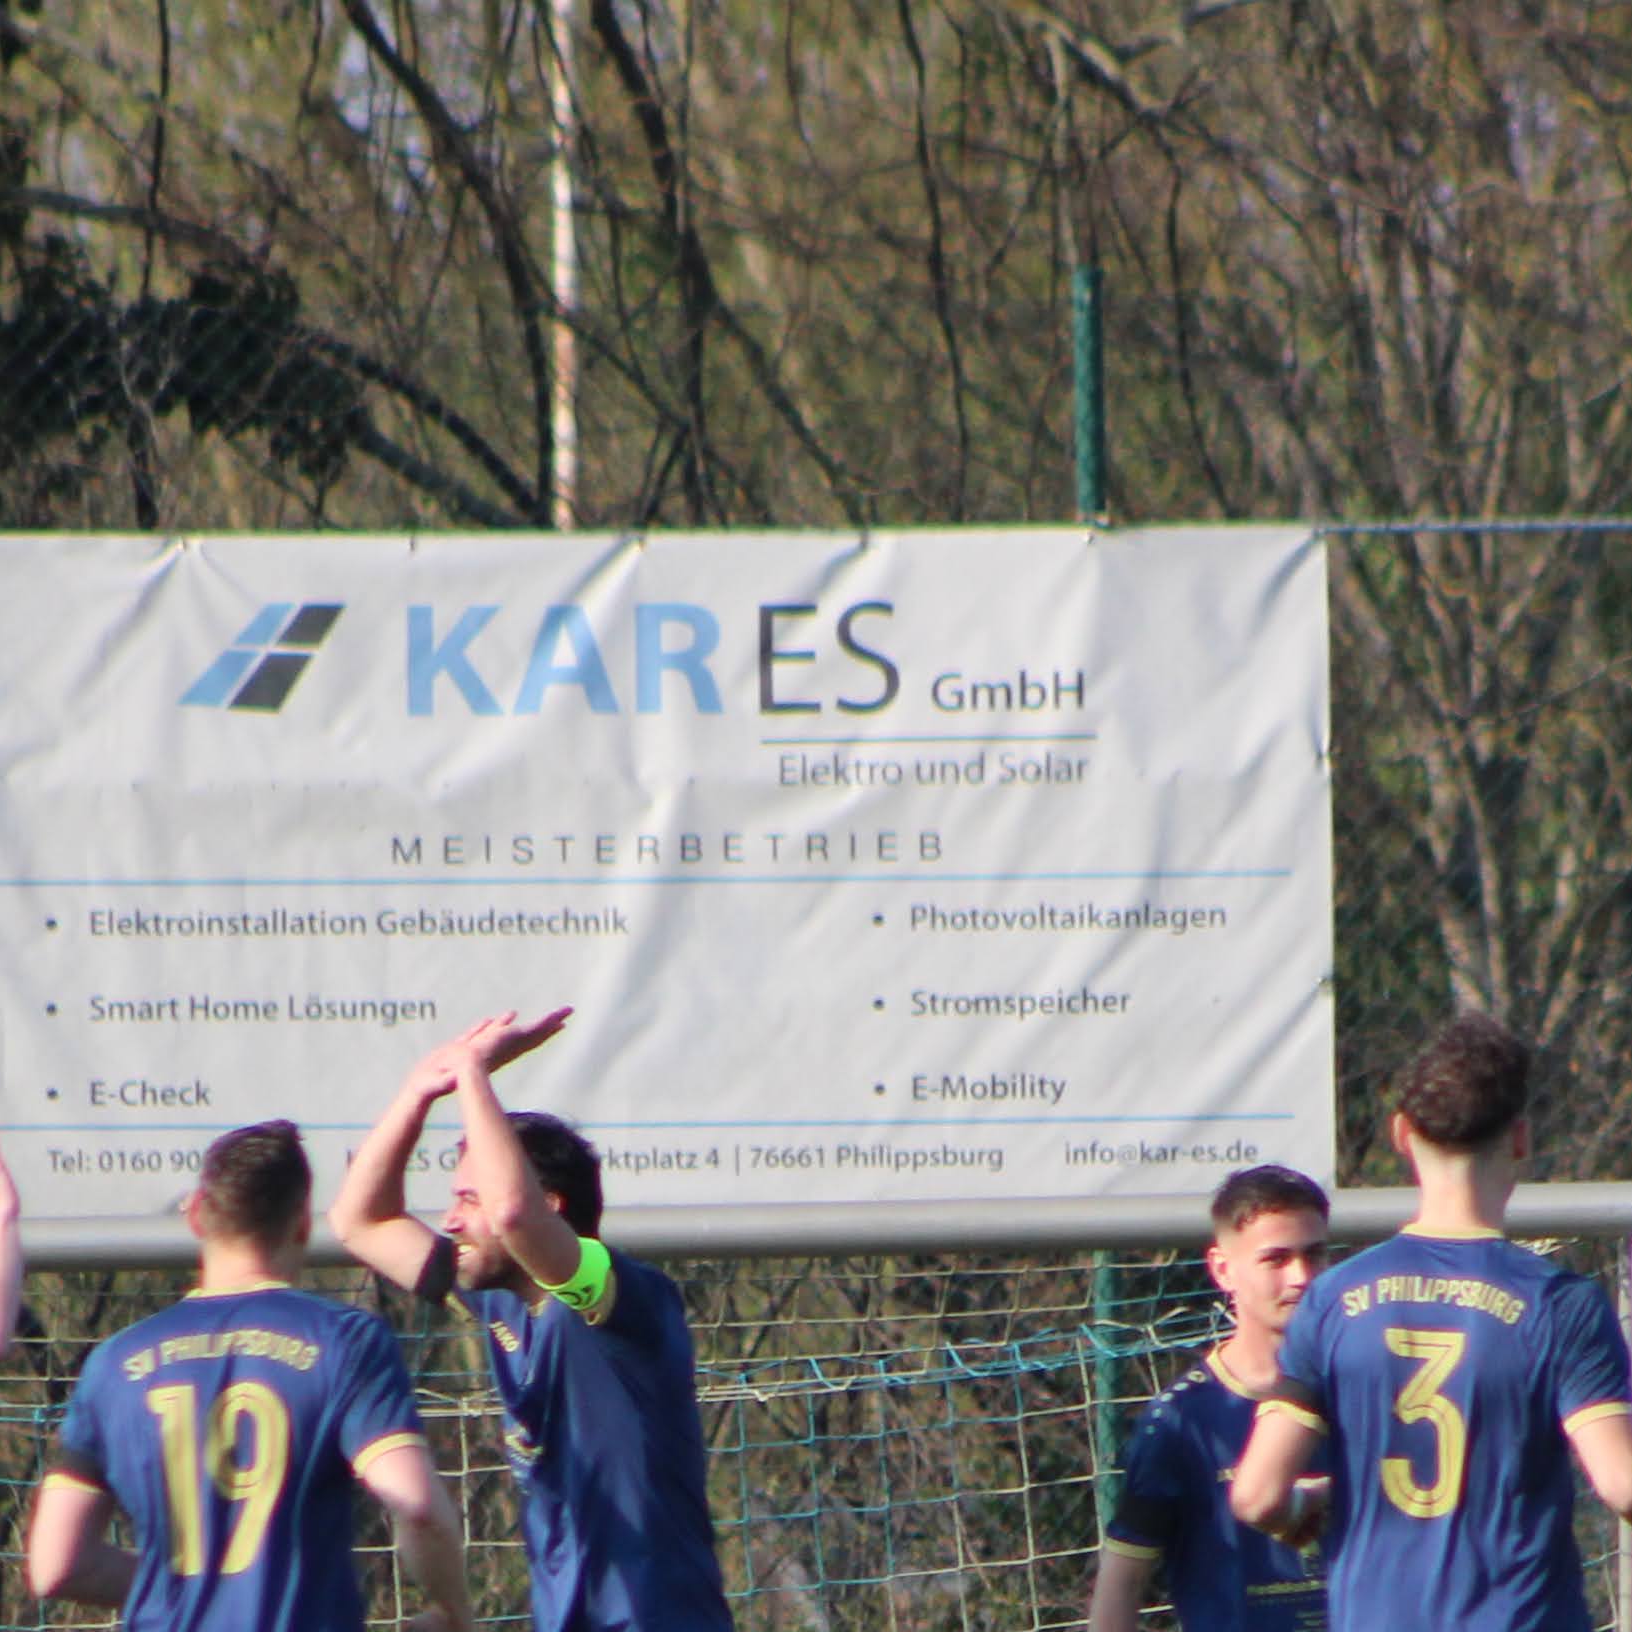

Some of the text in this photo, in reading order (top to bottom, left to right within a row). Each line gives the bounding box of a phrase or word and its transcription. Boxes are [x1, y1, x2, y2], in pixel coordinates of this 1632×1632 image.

[406, 601, 1088, 716] KARES GmbH
[778, 751, 1090, 787] Elektro und Solar
[391, 831, 944, 866] MEISTERBETRIEB
[89, 907, 629, 937] Elektroinstallation Gebäudetechnik
[910, 903, 1228, 936] Photovoltaikanlagen
[89, 995, 439, 1029] Smart Home Lösungen
[910, 988, 1133, 1020] Stromspeicher
[89, 1079, 213, 1107] E-Check
[910, 1073, 1069, 1106] E-Mobility
[47, 1149, 205, 1174] Tel: 0160 90
[705, 1147, 724, 1170] 4
[750, 1145, 828, 1170] 76661
[835, 1143, 1006, 1175] Philippsburg
[1065, 1139, 1261, 1168] info@kar-es.de
[1342, 1275, 1526, 1325] SV PHILIPPSBURG
[1380, 1327, 1466, 1520] 3
[146, 1382, 291, 1577] 19
